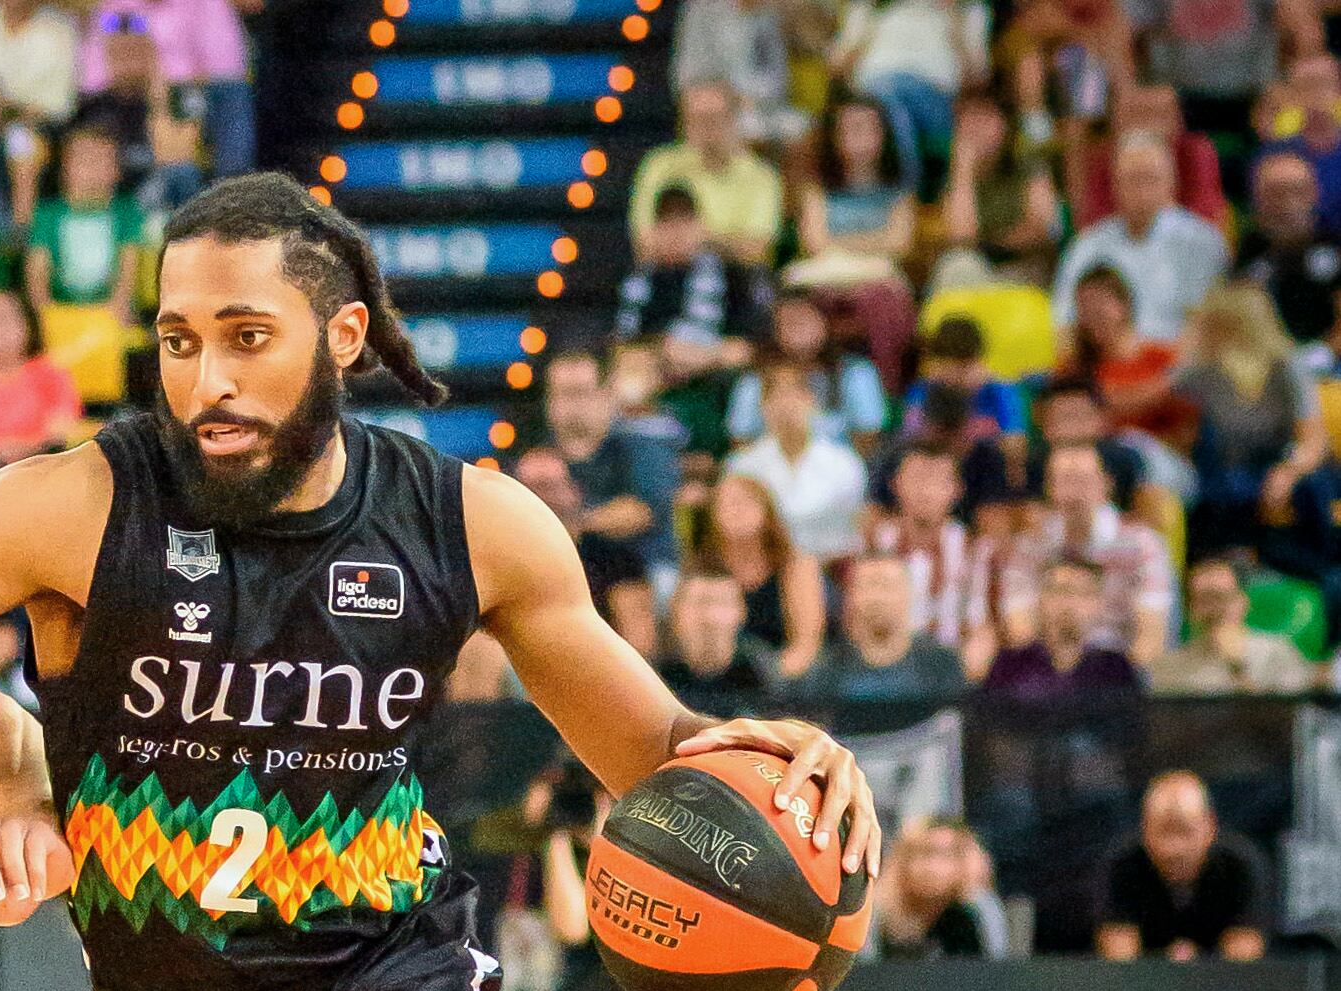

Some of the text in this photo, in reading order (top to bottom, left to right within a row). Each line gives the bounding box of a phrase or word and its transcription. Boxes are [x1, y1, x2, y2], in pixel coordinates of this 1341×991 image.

[338, 578, 366, 595] liga
[337, 594, 398, 611] endesa
[124, 656, 425, 730] surne
[118, 734, 221, 764] segros
[199, 808, 268, 914] 2
